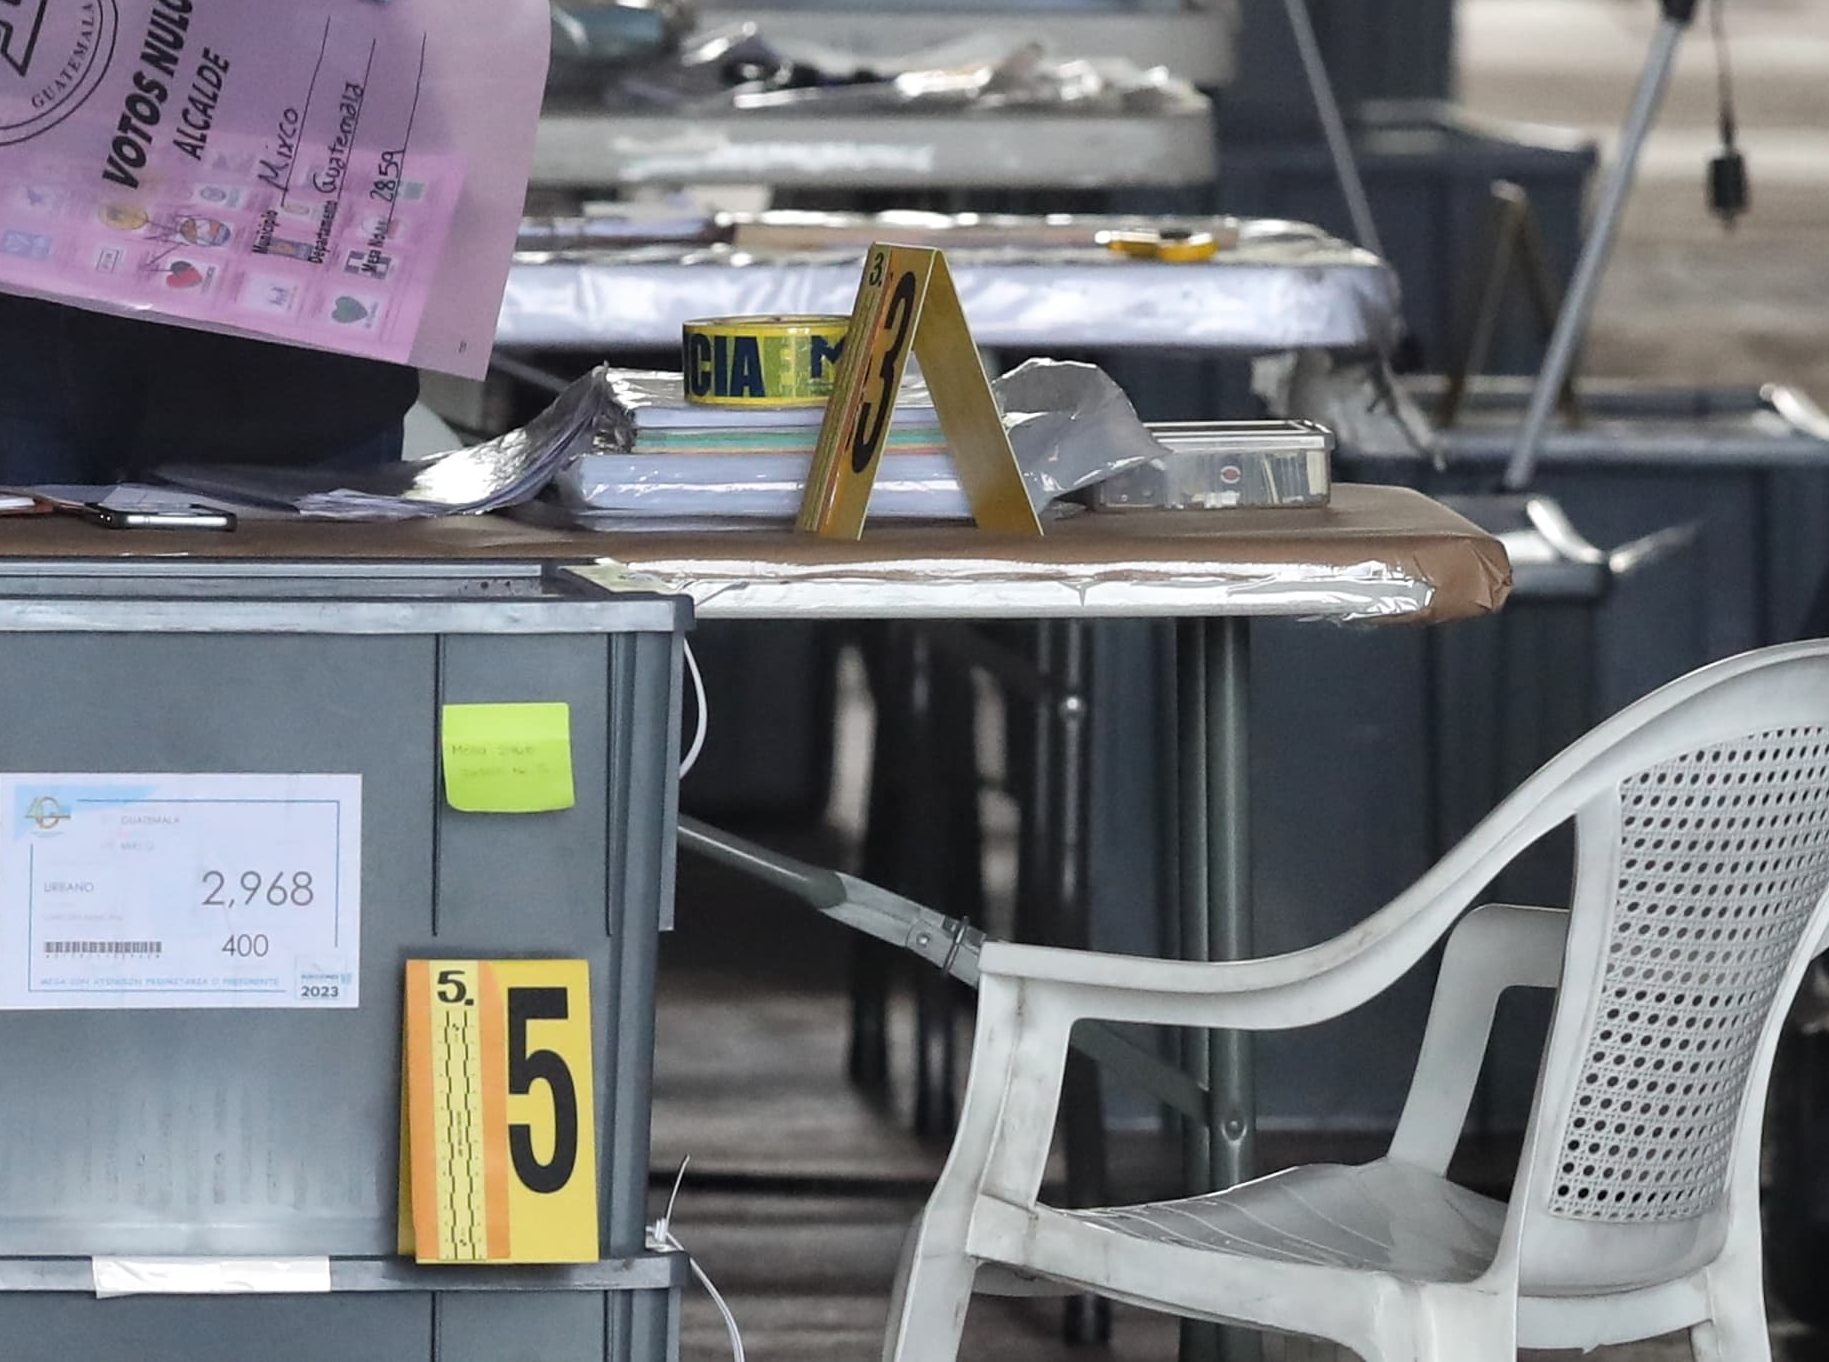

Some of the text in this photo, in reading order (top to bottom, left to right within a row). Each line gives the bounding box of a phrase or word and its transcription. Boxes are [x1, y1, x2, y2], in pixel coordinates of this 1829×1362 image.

[102, 70, 168, 190] VOTOS
[173, 46, 230, 161] ALCALDE
[312, 81, 364, 195] Guatemala
[369, 150, 406, 203] 2859
[851, 270, 916, 474] 3
[43, 880, 95, 894] URBANO
[201, 869, 315, 909] 2,968
[221, 933, 269, 957] 400
[300, 985, 340, 998] 2023
[436, 969, 475, 1007] 5.
[507, 986, 579, 1195] 5
